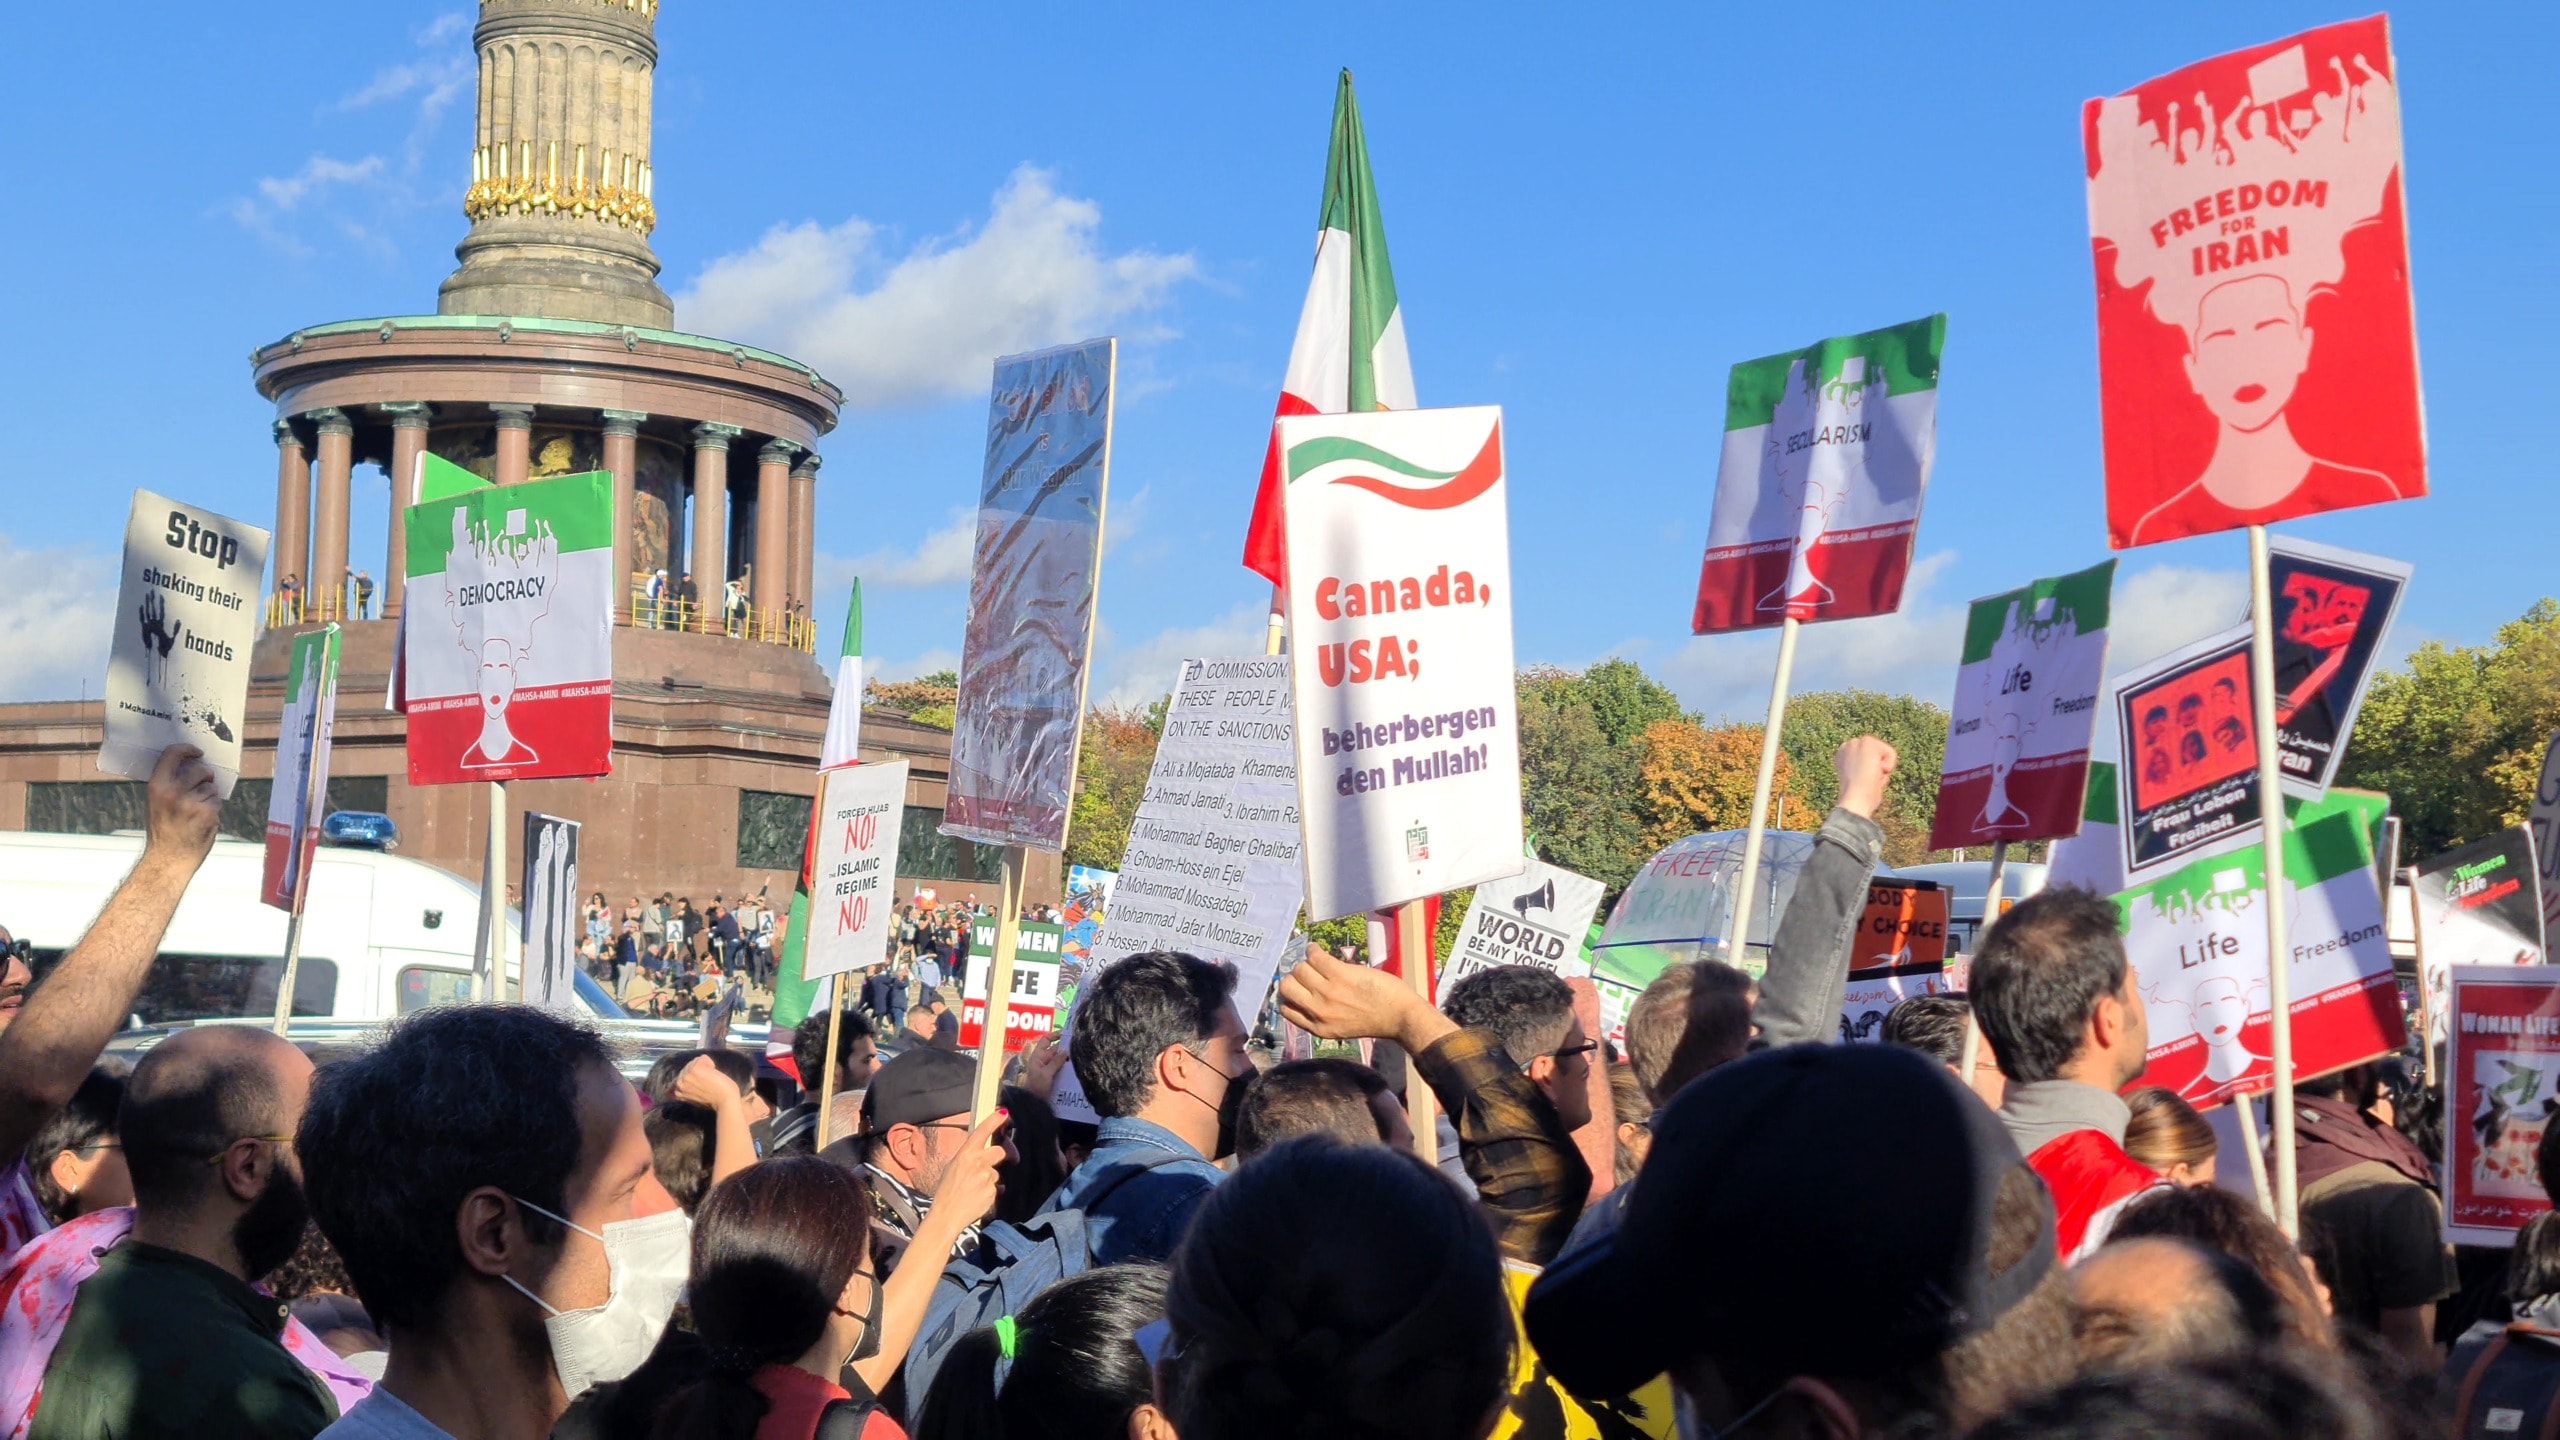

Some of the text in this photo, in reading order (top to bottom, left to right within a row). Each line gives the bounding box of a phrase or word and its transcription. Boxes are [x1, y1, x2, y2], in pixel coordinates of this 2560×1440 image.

[2150, 178, 2329, 248] FREEDOM
[2220, 216, 2256, 236] FOR
[2191, 225, 2291, 277] IRAN
[1785, 421, 1871, 455] SECULARISM
[166, 510, 238, 569] Stop
[143, 567, 243, 610] shaking their
[460, 576, 545, 607] DEMOCRACY
[1315, 564, 1491, 621] Canada,
[185, 629, 233, 661] hands
[1317, 635, 1420, 688] USA;
[2001, 662, 2032, 695] Life
[119, 702, 172, 721] #MahsaAmini
[1178, 690, 1216, 707] THESE
[1224, 689, 1276, 707] PEOPLE
[1168, 720, 1291, 741] ON THE SANCTIONS
[1322, 706, 1496, 756] beherbergen
[1153, 759, 1295, 782] 1. Ali & Mojataba Khamene
[1336, 743, 1488, 797] den Mullah!
[2279, 749, 2313, 772] ran
[837, 803, 889, 820] FORCED HIJAB
[1152, 787, 1191, 806] Ahmad
[1191, 791, 1227, 810] Janati
[1224, 802, 1233, 820] 3.
[1235, 803, 1280, 822] Ibrahim
[2153, 787, 2246, 832] Frau Leben
[845, 814, 876, 854] NO!
[1131, 823, 1300, 860] 4. Mohammad Bagher Ghalibaf
[2168, 813, 2234, 848] Freiheit
[837, 857, 880, 877] ISLAMIC
[1123, 850, 1132, 865] 5.
[1222, 865, 1245, 885] Ejei
[1650, 850, 1721, 877] FREE
[835, 876, 878, 896] REGIME
[1115, 875, 1248, 918] 6. Mohammad Mossadegh
[2458, 876, 2487, 897] Life
[838, 893, 868, 936] NO!
[1627, 888, 1706, 925] IRAN
[976, 926, 1059, 953] WMEN
[1095, 930, 1103, 946] 8.
[1106, 932, 1148, 952] Hossein
[1105, 904, 1264, 949] 7. Mohammad Jafar Montazeri
[1477, 912, 1564, 961] WORLD
[1873, 916, 1942, 938] CHOICE
[1467, 936, 1486, 950] BE
[1487, 943, 1511, 960] MY
[2180, 923, 2382, 970] Life Freedom
[1085, 957, 1094, 973] 9.
[963, 1005, 1052, 1032] FRDOM
